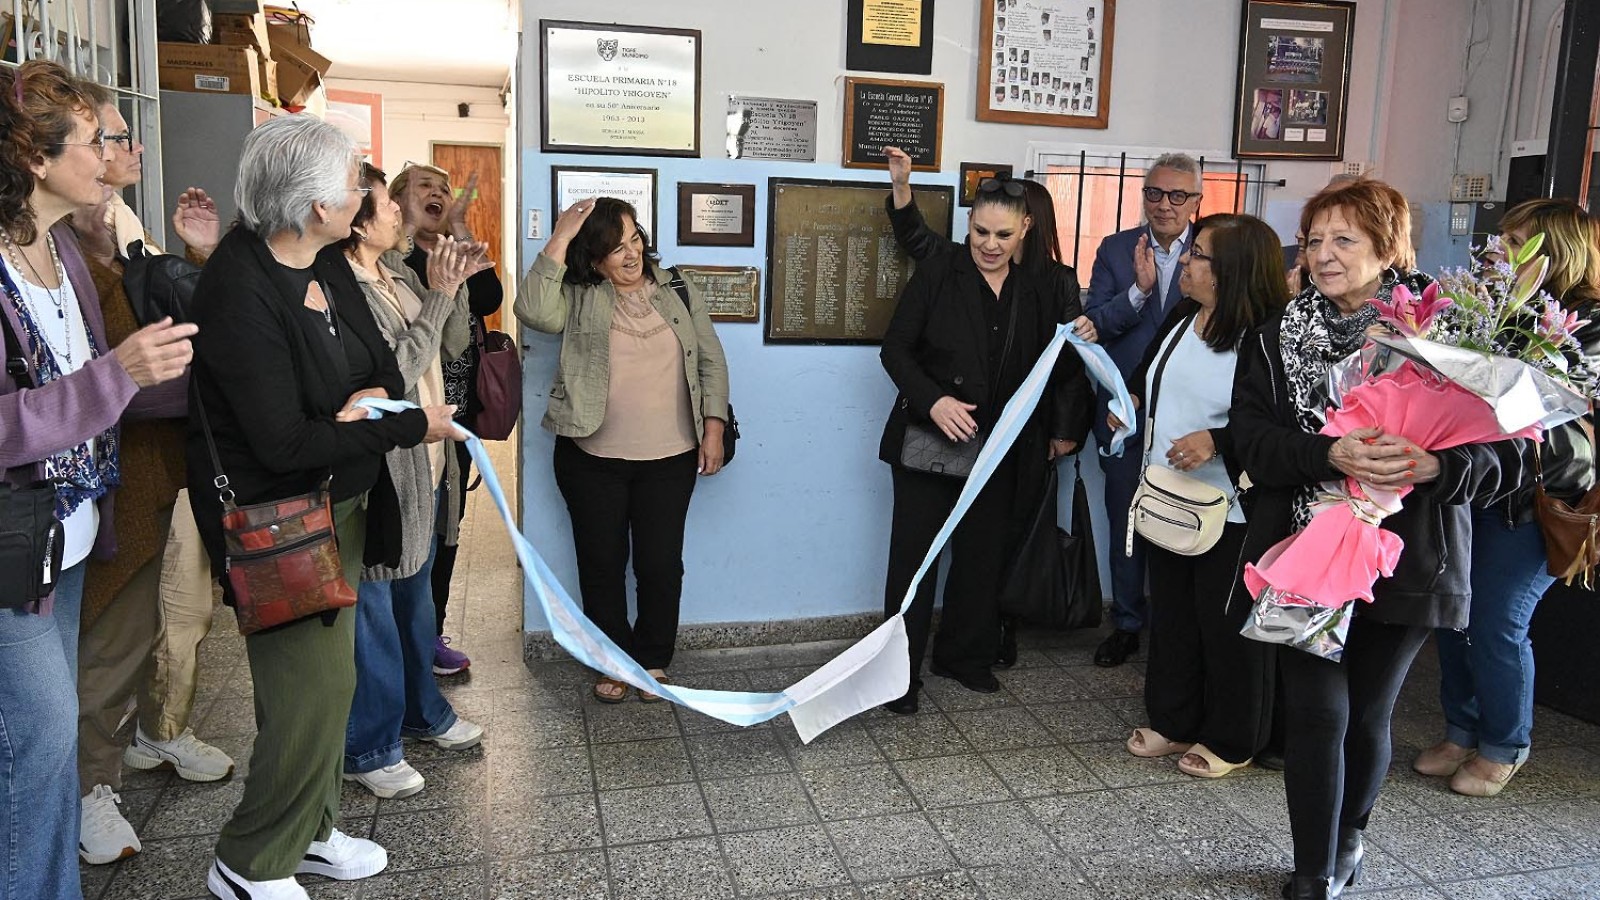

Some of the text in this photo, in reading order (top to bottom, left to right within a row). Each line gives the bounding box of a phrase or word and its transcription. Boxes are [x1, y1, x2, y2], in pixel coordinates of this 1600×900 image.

[568, 74, 610, 83] ESCUELA
[613, 76, 655, 85] PRIMARIA
[860, 90, 866, 99] La
[868, 91, 884, 101] Escuela
[886, 92, 903, 102] General
